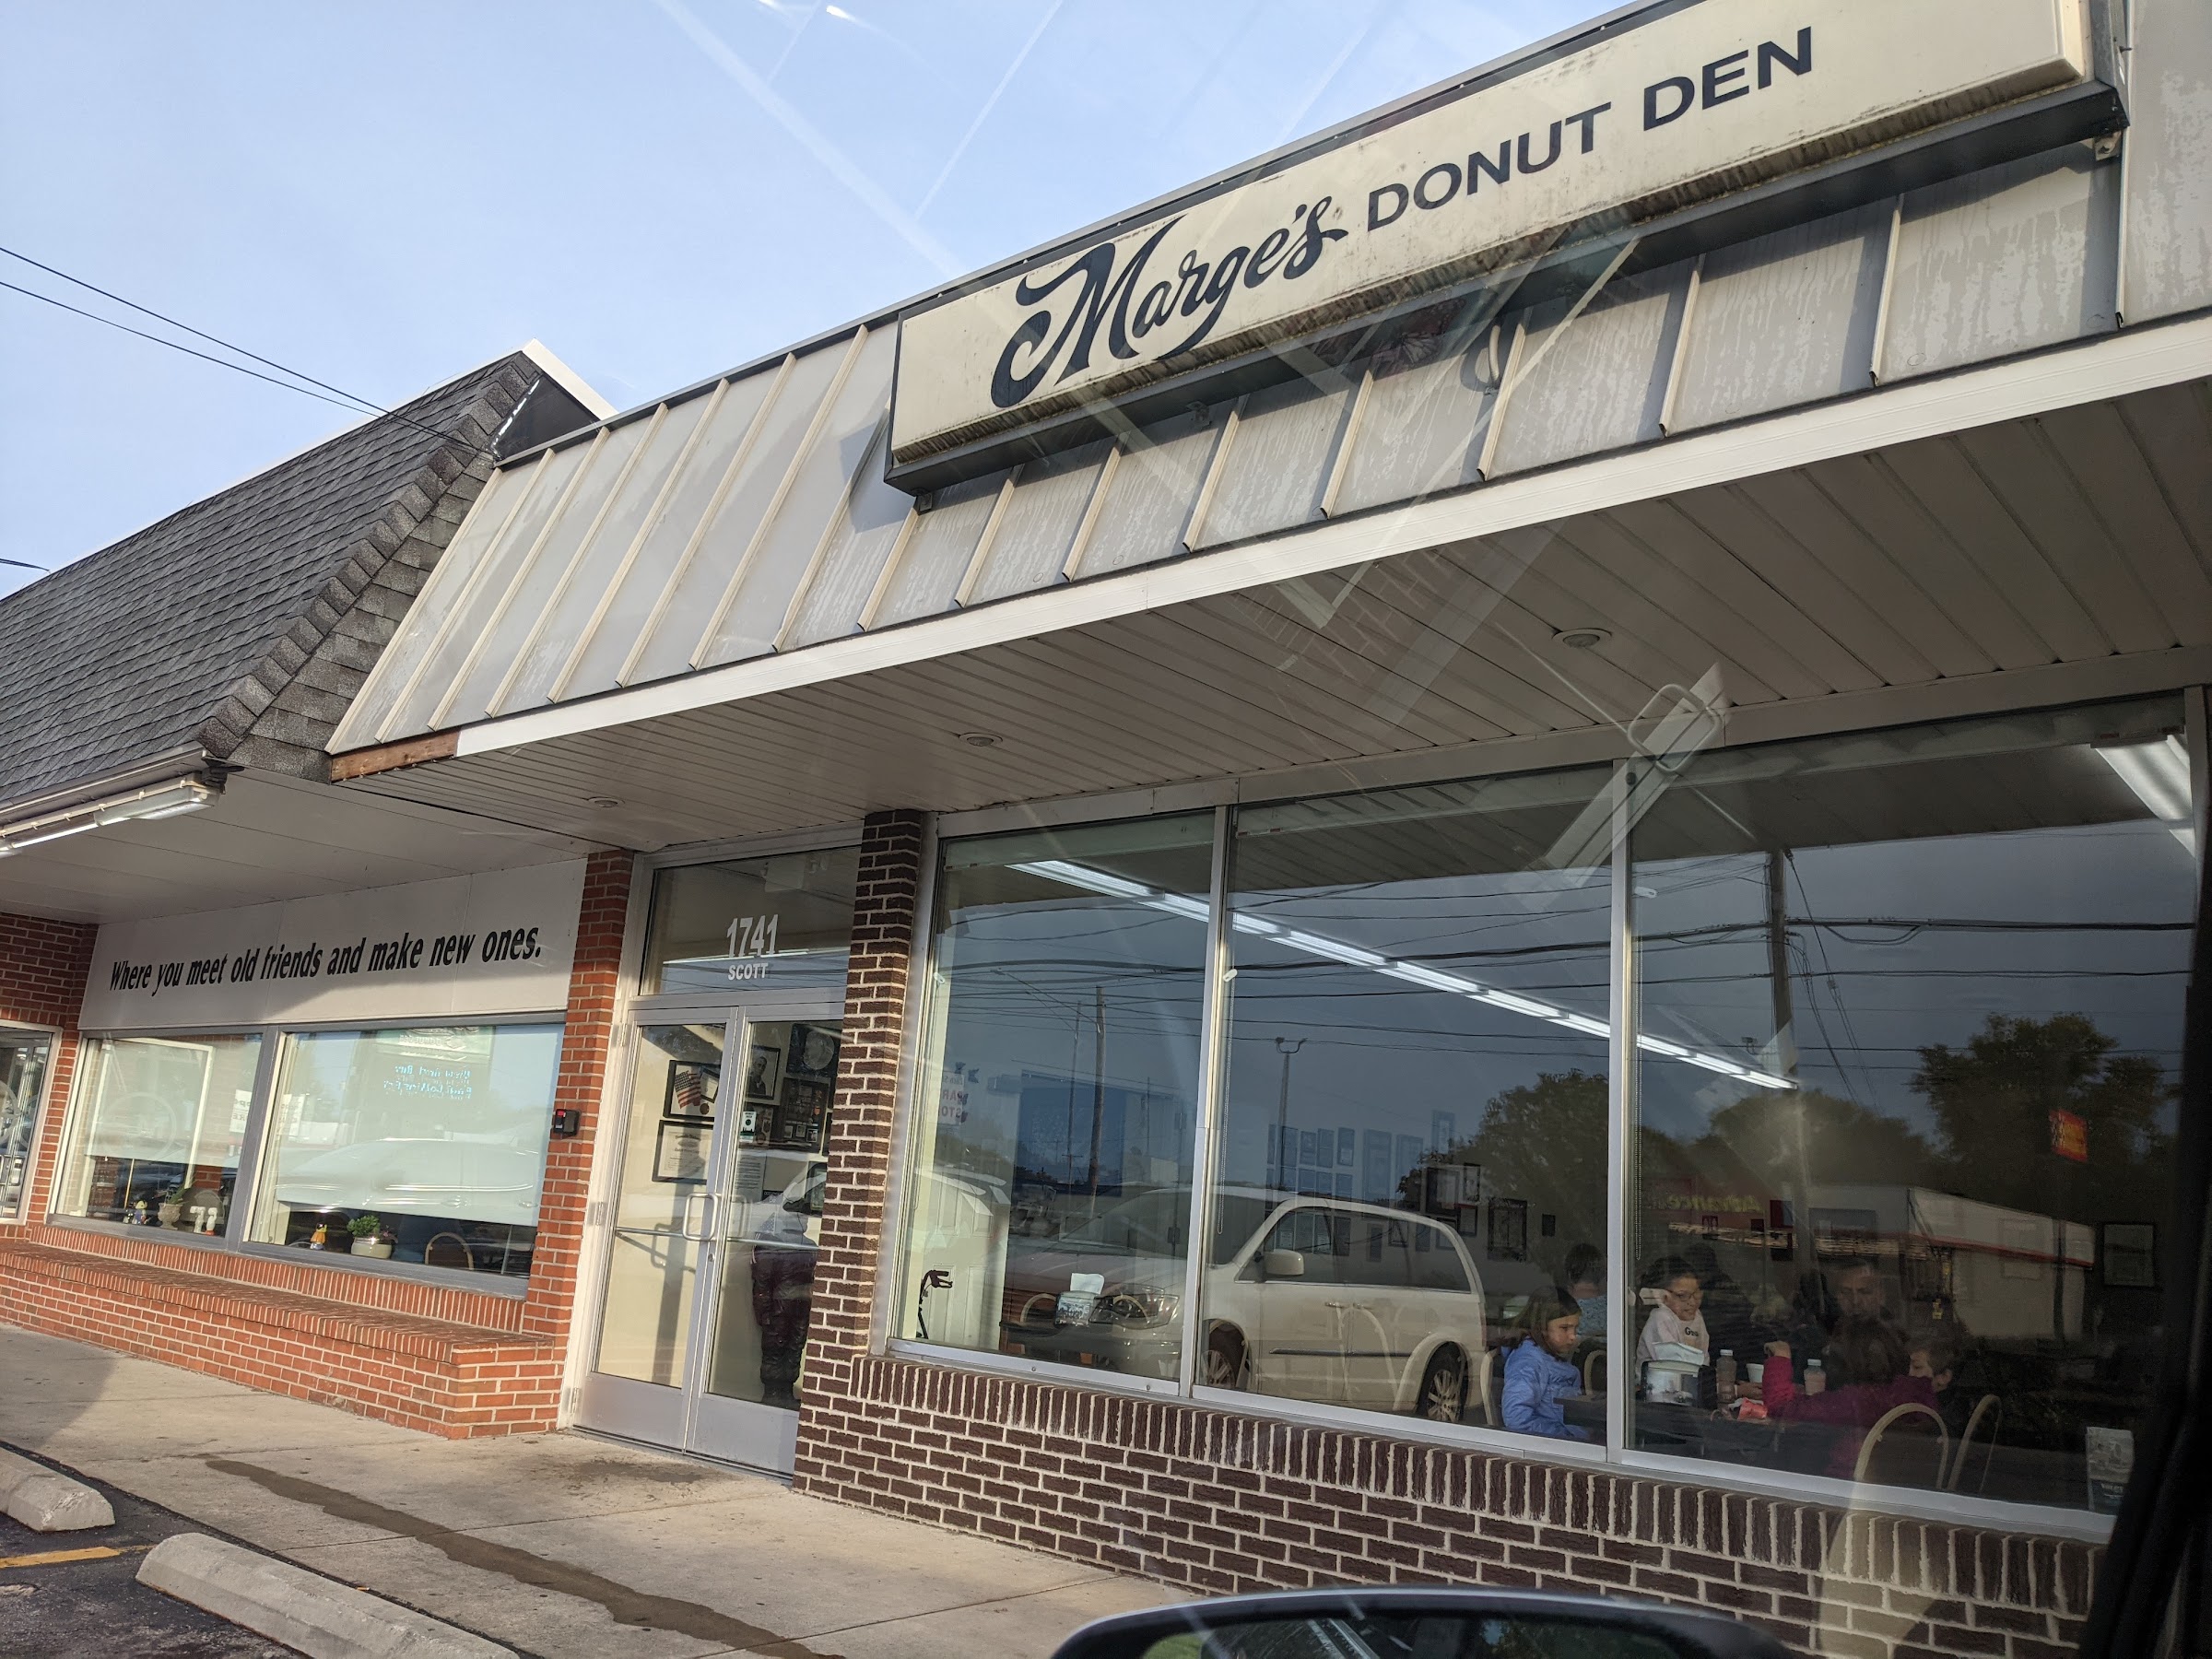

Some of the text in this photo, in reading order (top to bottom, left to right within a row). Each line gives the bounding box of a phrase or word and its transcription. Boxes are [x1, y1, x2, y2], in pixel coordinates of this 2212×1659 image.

[990, 26, 1812, 408] Marge's DONUT DEN
[109, 927, 541, 997] Where you meet old friends and make new ones.
[726, 913, 779, 959] 1741
[727, 962, 769, 981] SCOTT
